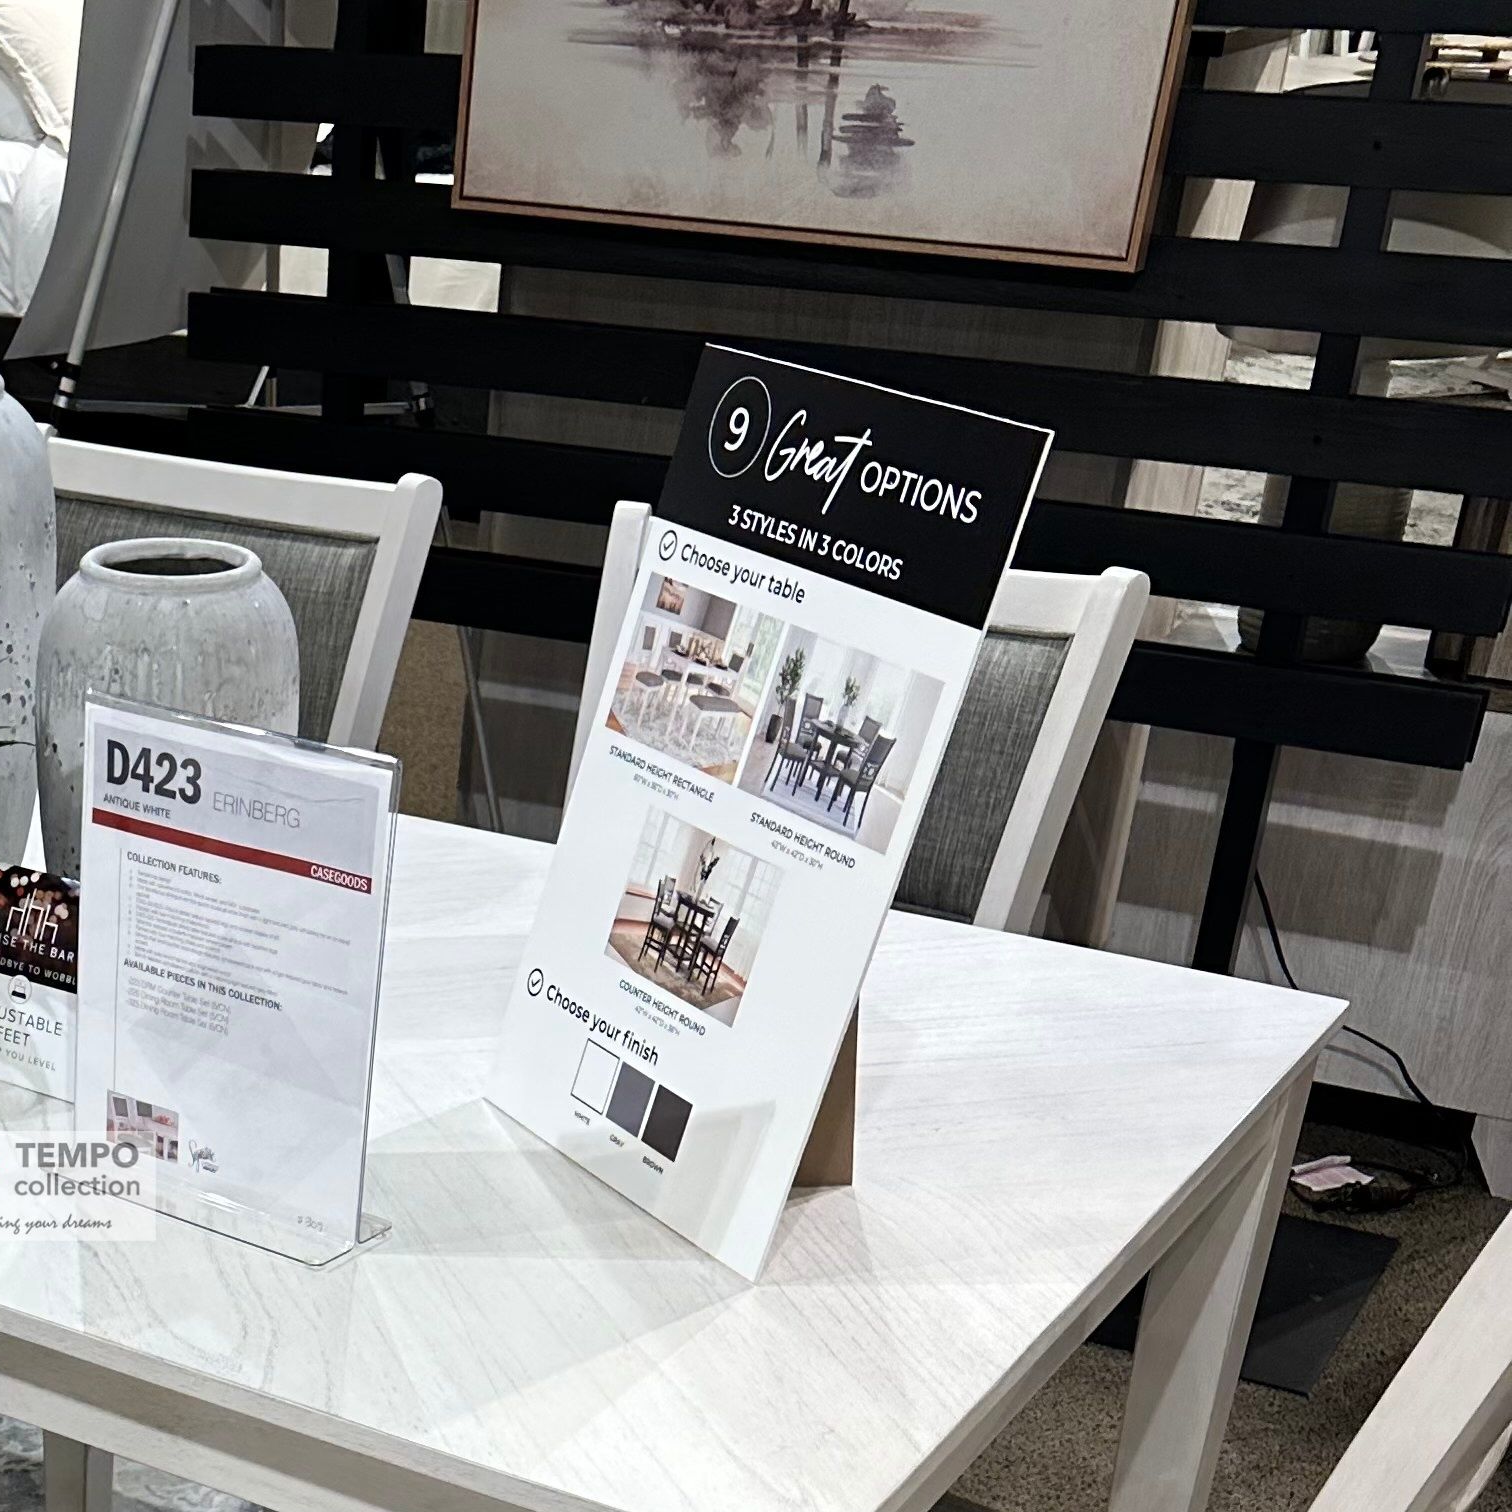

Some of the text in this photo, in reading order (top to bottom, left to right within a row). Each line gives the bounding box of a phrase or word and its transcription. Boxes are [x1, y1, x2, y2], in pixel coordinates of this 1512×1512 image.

[723, 407, 982, 524] 9 Great OPTIONS
[728, 504, 904, 581] 3 STYLES IN 3 COLORS
[681, 543, 806, 604] Choose your table
[106, 739, 301, 828] D423 ERINBERG
[609, 745, 714, 803] STANDARD HEIGHT RECTANGLE
[103, 793, 171, 819] ANTIQUE WHITE
[126, 851, 176, 873] COLLECTION
[178, 864, 222, 884] FEATURES:
[750, 812, 855, 868] STANDARD HEIGHT ROUND
[310, 864, 368, 891] CASEGOODS
[23, 939, 45, 956] THE
[50, 946, 75, 963] BAR
[28, 963, 41, 976] TO
[123, 958, 165, 978] AVAILABLE
[167, 972, 196, 987] PIECES
[197, 979, 206, 990] IN
[207, 982, 226, 997] THIS
[228, 987, 283, 1011] COLLECTION:
[619, 979, 706, 1036] COUNTER HEIGHT ROUND
[546, 985, 658, 1066] Choose your finish
[5, 1048, 24, 1062] YOU
[28, 1056, 56, 1072] LEVEL
